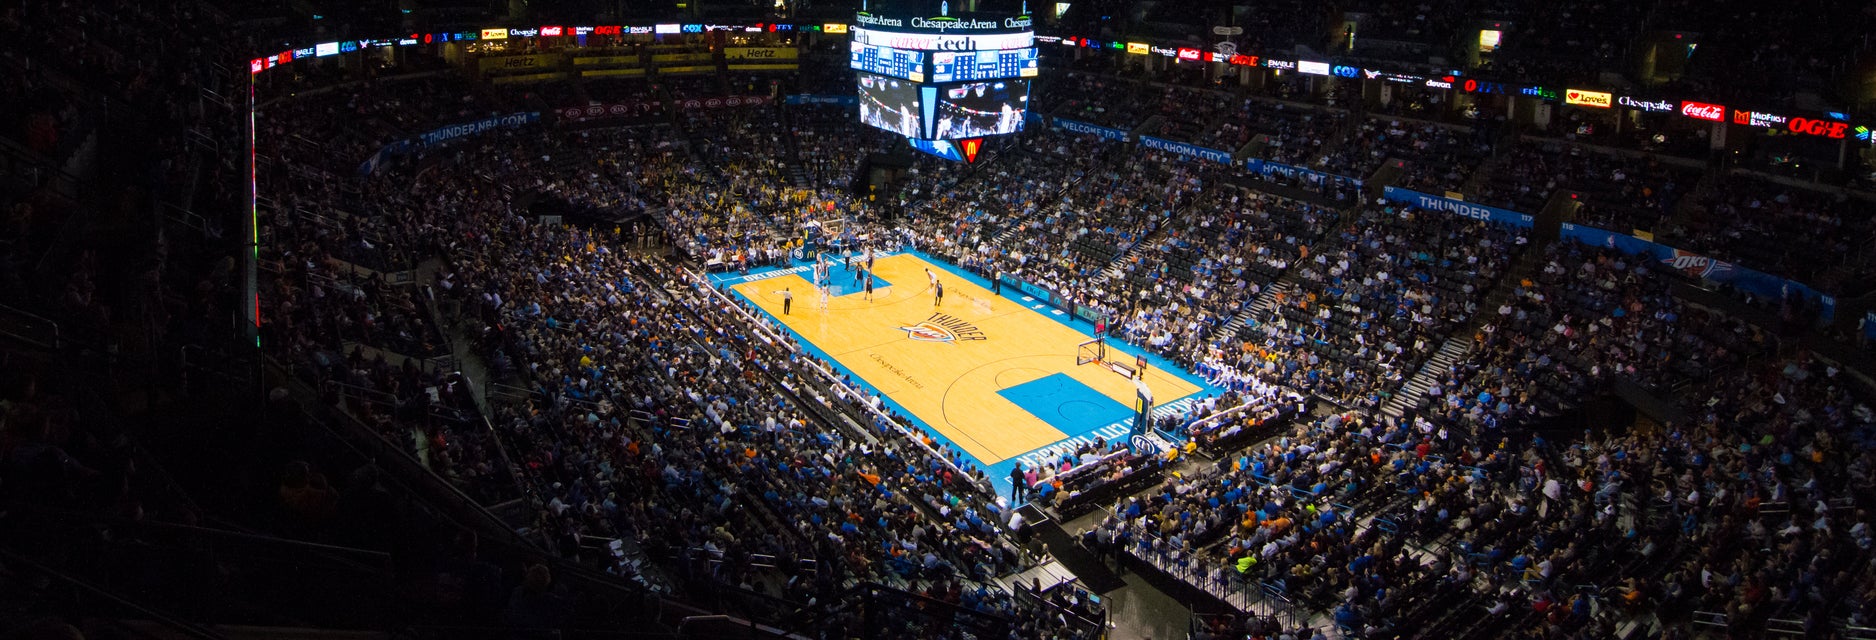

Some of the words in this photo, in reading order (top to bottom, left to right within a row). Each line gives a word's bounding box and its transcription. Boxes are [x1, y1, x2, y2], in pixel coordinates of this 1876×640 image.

[878, 15, 902, 27] Arena
[911, 17, 970, 32] Chesapeake
[970, 18, 997, 29] Arena
[936, 36, 977, 51] tech
[747, 49, 775, 58] Hertz
[504, 57, 534, 67] Hertz
[1426, 79, 1451, 88] devon
[1580, 94, 1607, 104] Love's
[1618, 96, 1673, 111] Chesapeake
[1061, 121, 1101, 136] WELCOME
[1103, 129, 1116, 139] TO
[1145, 138, 1197, 158] OKLAHOMA
[1384, 186, 1394, 194] 117
[1419, 196, 1491, 221] THUNDER
[1521, 214, 1533, 223] 117
[1562, 222, 1574, 231] 118
[1673, 254, 1708, 270] OKC
[743, 265, 811, 282] OKLAHOMA
[927, 312, 987, 341] THUNDER
